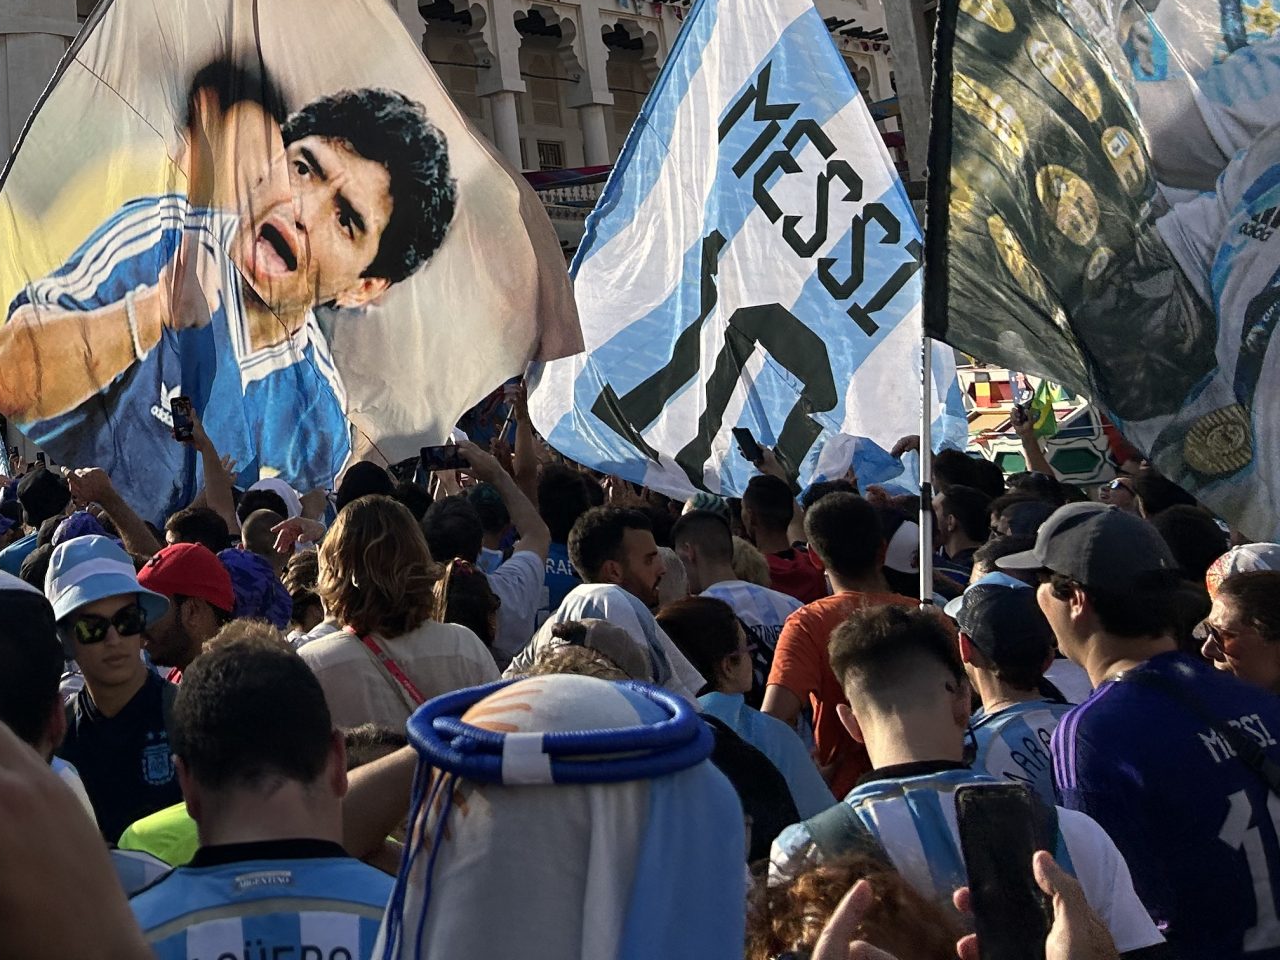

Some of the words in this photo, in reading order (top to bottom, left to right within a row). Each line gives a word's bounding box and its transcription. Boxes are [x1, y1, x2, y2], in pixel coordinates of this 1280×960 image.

[718, 59, 923, 337] MESSI
[1197, 713, 1277, 763] MSI
[1218, 789, 1280, 952] 1
